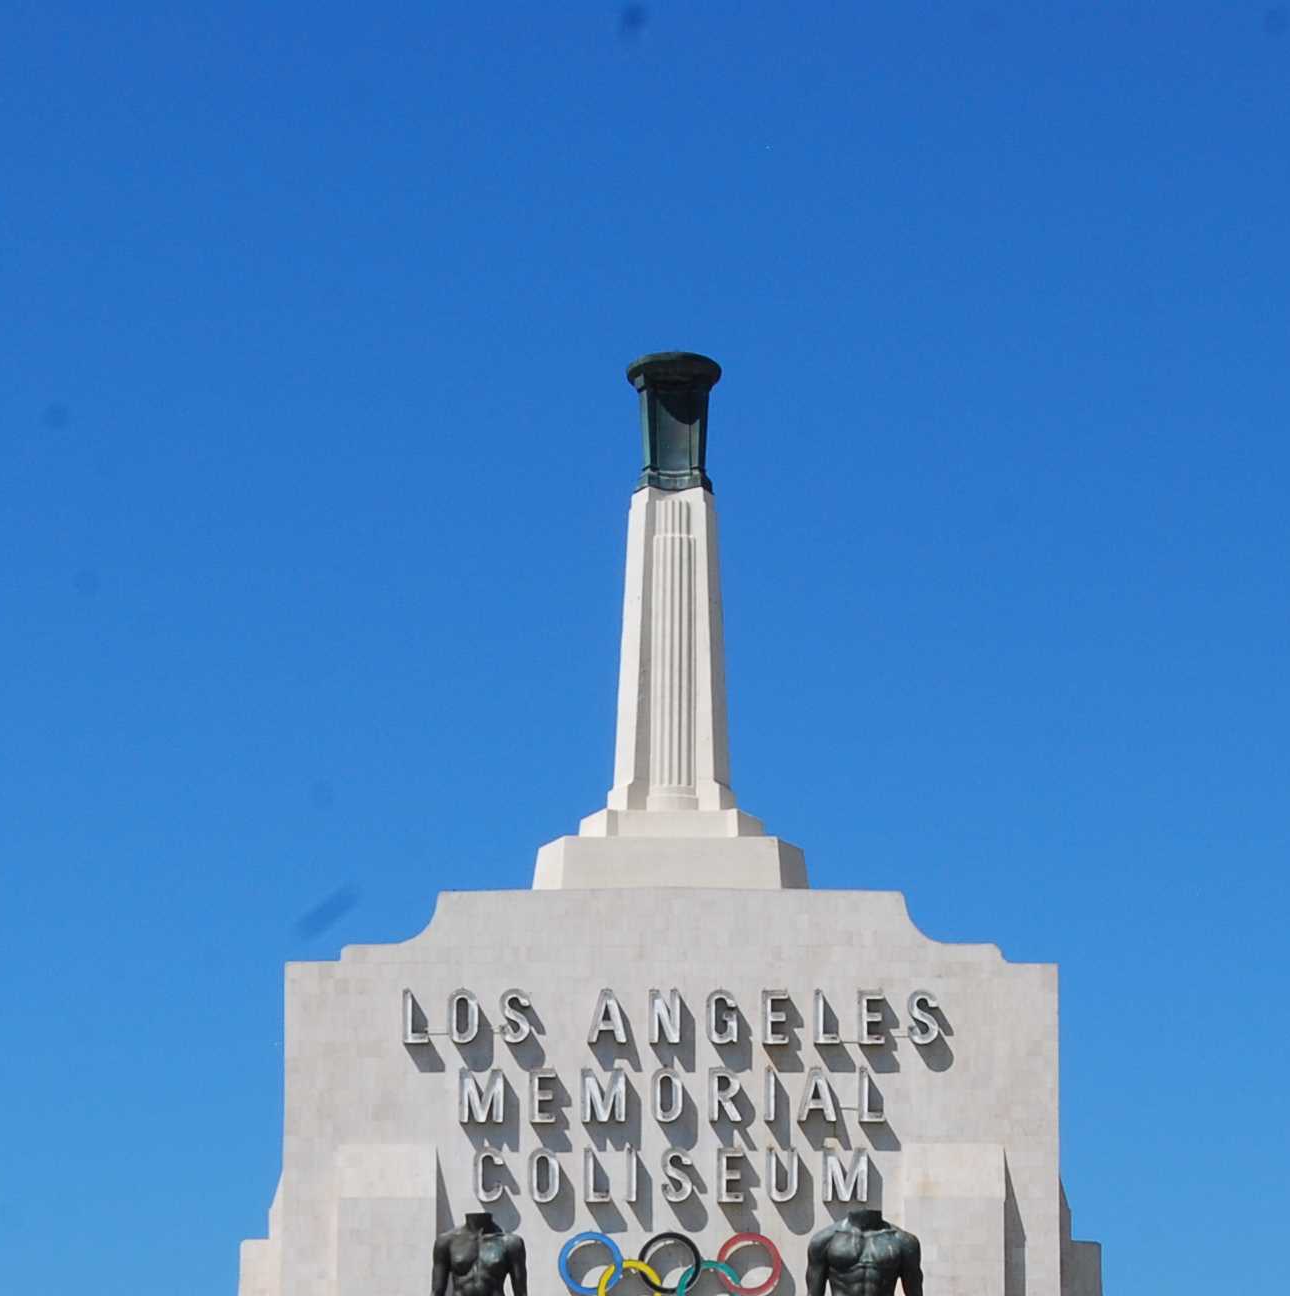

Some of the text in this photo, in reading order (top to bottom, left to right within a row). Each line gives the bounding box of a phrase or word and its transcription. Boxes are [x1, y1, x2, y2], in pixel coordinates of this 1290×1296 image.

[402, 988, 939, 1044] LOS ANGELES
[459, 1066, 885, 1123] MEMORIAL
[473, 1147, 869, 1203] COLISEUM
